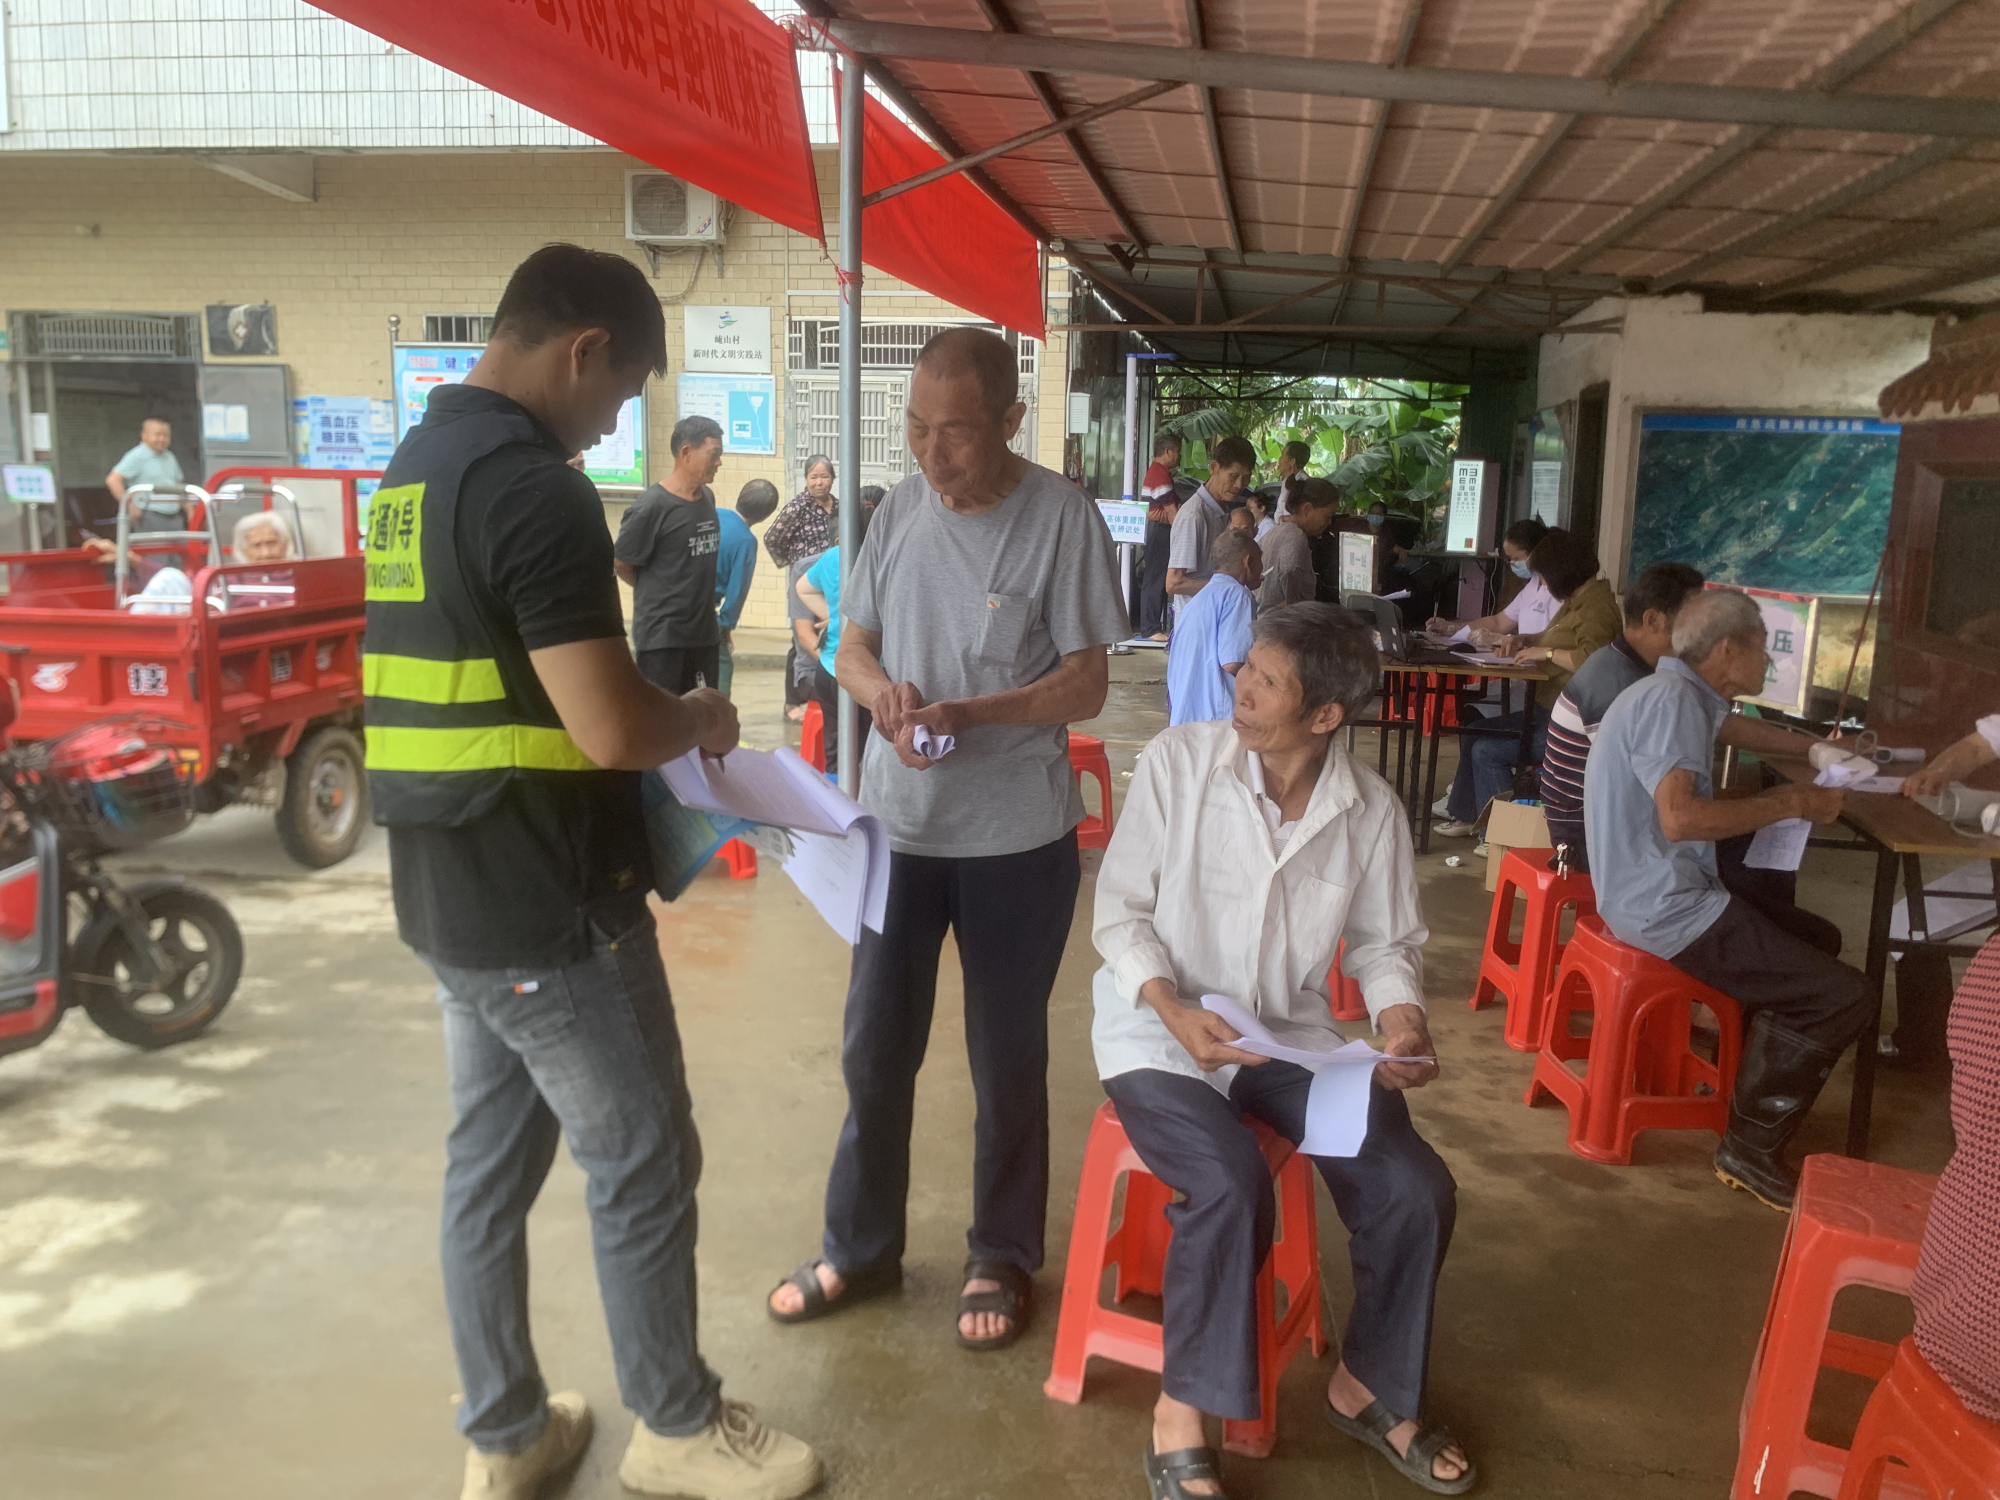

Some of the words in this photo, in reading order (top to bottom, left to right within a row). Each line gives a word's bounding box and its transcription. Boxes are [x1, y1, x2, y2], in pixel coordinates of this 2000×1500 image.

[693, 348, 763, 360] 新时代文明实践站
[320, 414, 360, 429] 高血压
[321, 431, 360, 444] 糖尿病
[1104, 514, 1145, 526] 高体重腰围
[1110, 525, 1141, 535] 医辨识处
[1768, 628, 1795, 655] 压
